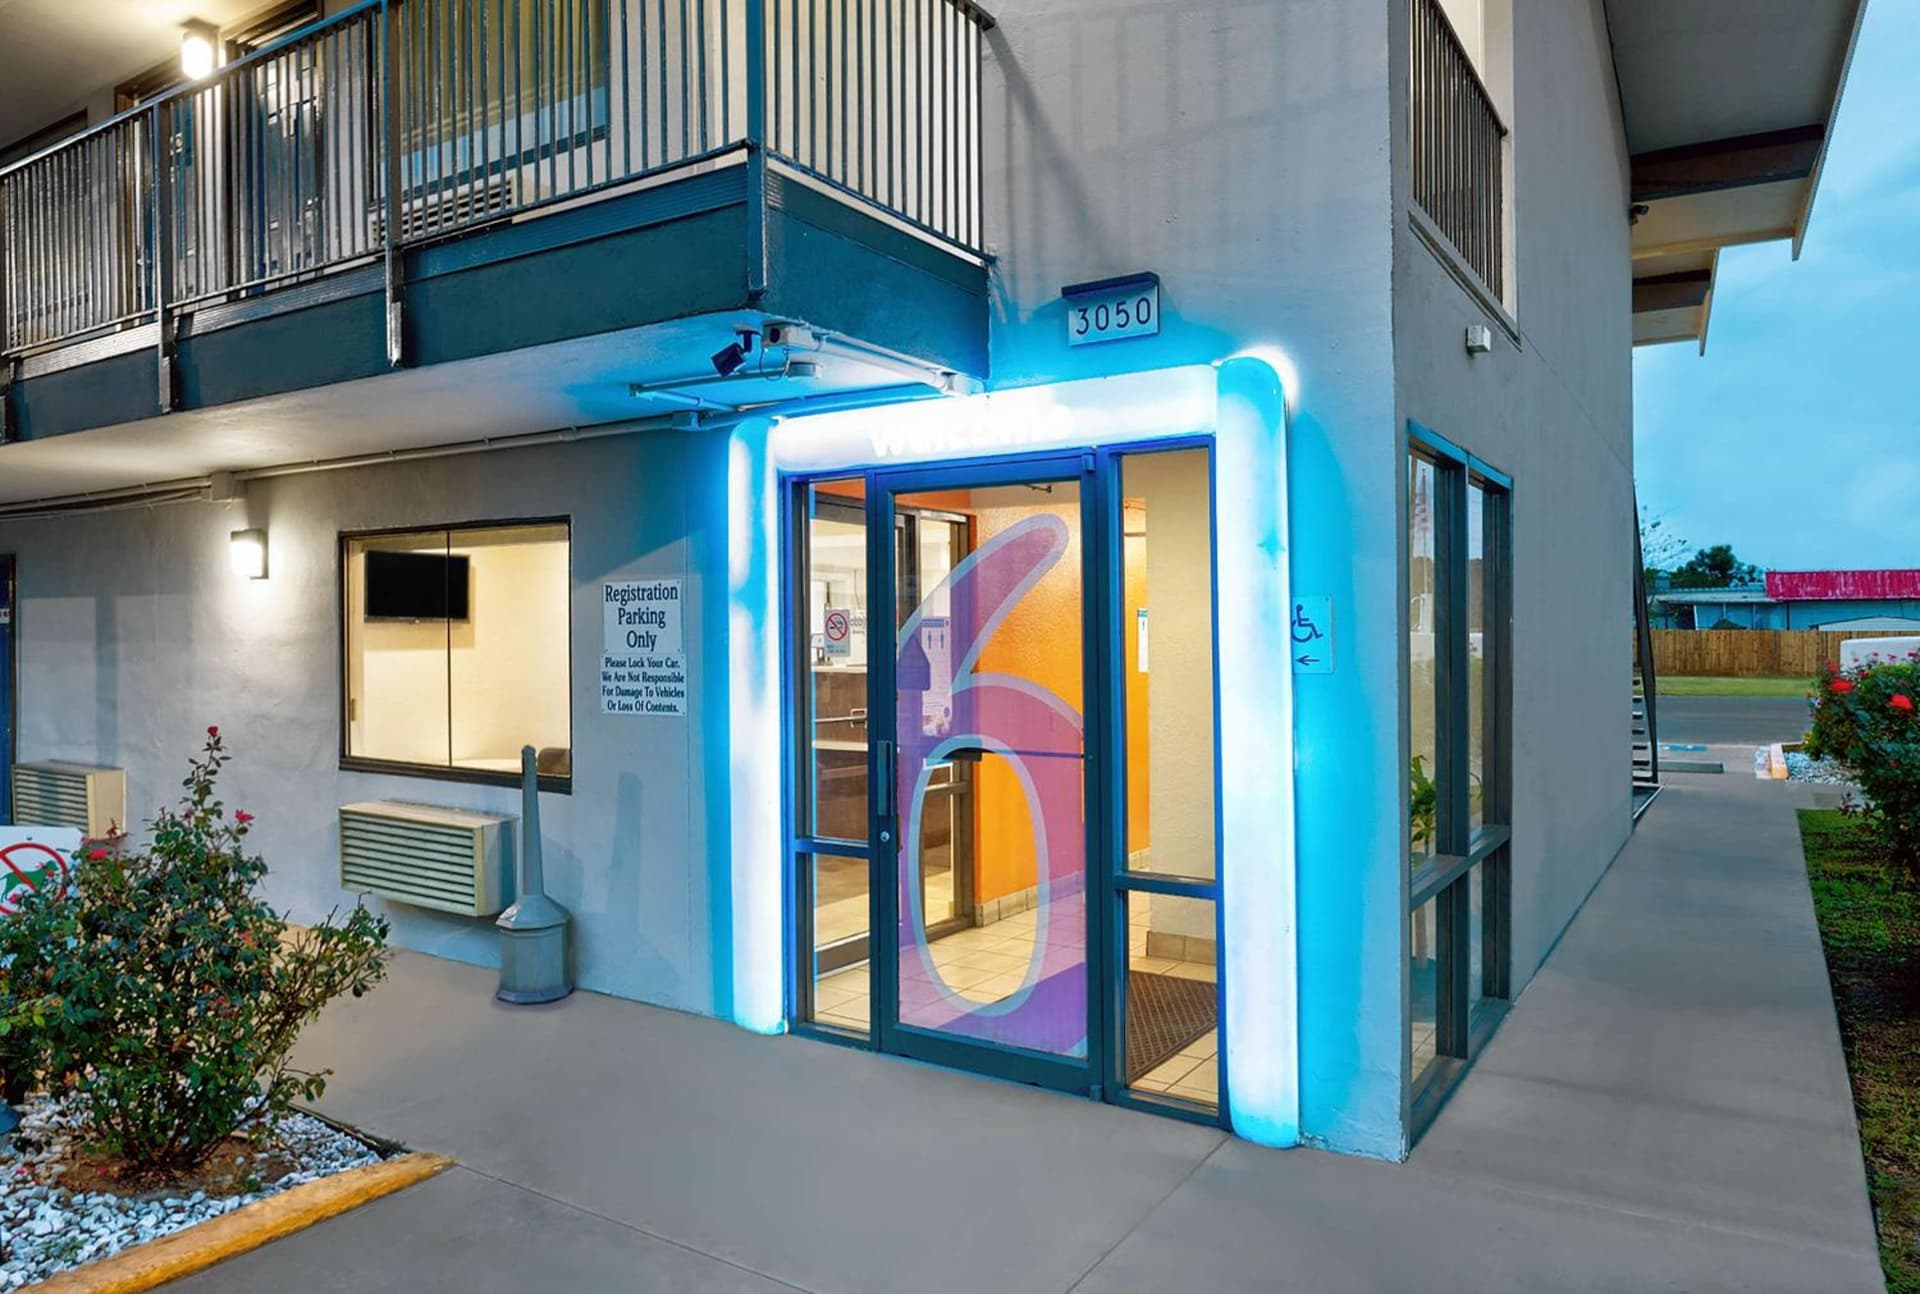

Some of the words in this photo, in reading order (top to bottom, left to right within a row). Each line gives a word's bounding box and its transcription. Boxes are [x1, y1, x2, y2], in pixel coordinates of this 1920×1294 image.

[1076, 297, 1151, 335] 3050
[605, 583, 678, 606] Registration
[618, 607, 666, 629] Parking
[626, 630, 657, 652] Only
[605, 657, 627, 668] Please
[628, 657, 645, 668] Lock
[647, 657, 664, 668] Your
[665, 657, 680, 668] Car.
[602, 671, 612, 682] We
[614, 671, 626, 682] Are
[628, 672, 641, 682] Not
[642, 672, 684, 685] Responsible
[602, 685, 614, 697] For
[615, 686, 643, 699] Damage
[644, 686, 655, 698] To
[655, 687, 685, 698] Vehicles
[607, 700, 617, 711] Or
[617, 701, 633, 712] Loss
[634, 701, 645, 712] Of
[645, 701, 680, 713] Contents.
